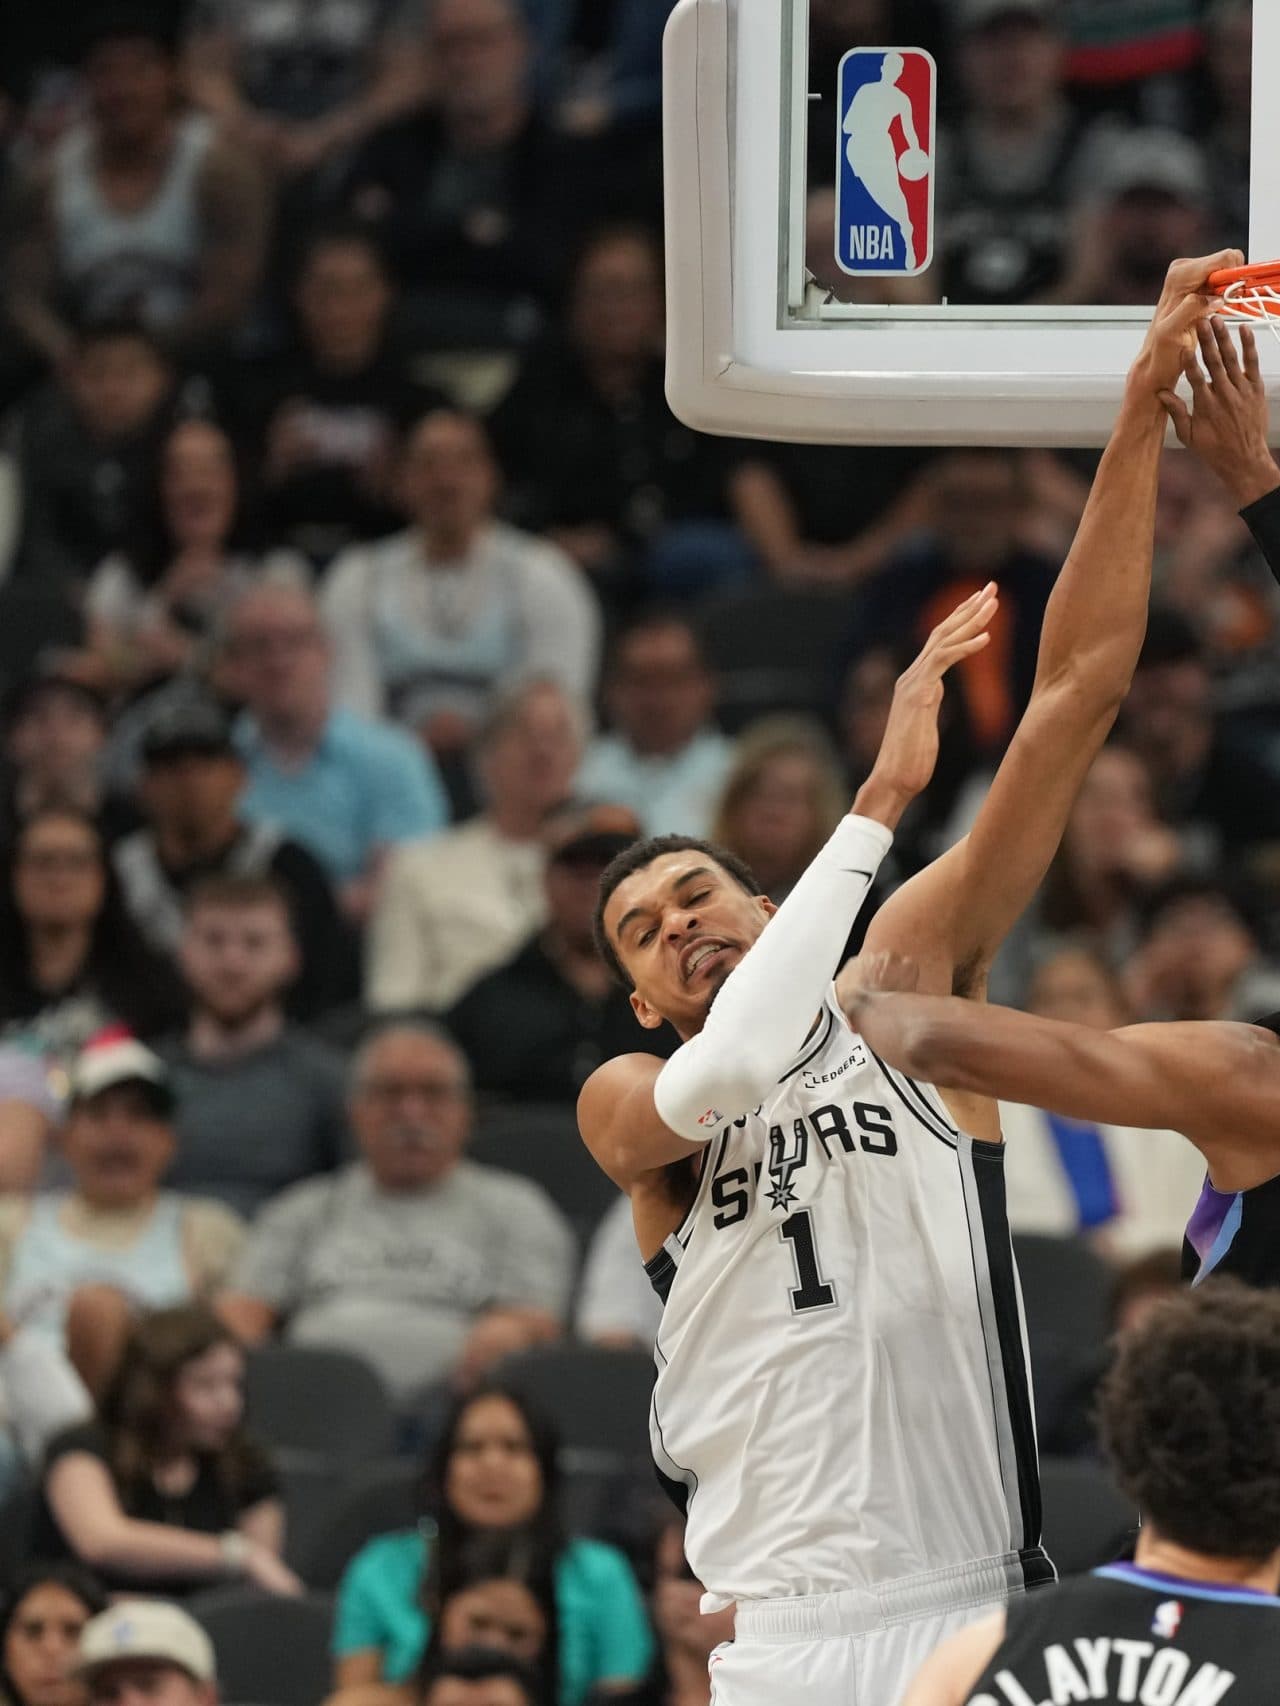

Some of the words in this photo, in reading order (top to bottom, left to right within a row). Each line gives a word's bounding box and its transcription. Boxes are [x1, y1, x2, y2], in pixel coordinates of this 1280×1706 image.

[849, 225, 894, 260] NBA
[812, 1055, 857, 1084] LEDGER
[711, 1101, 898, 1230] SURS
[777, 1206, 839, 1316] 1
